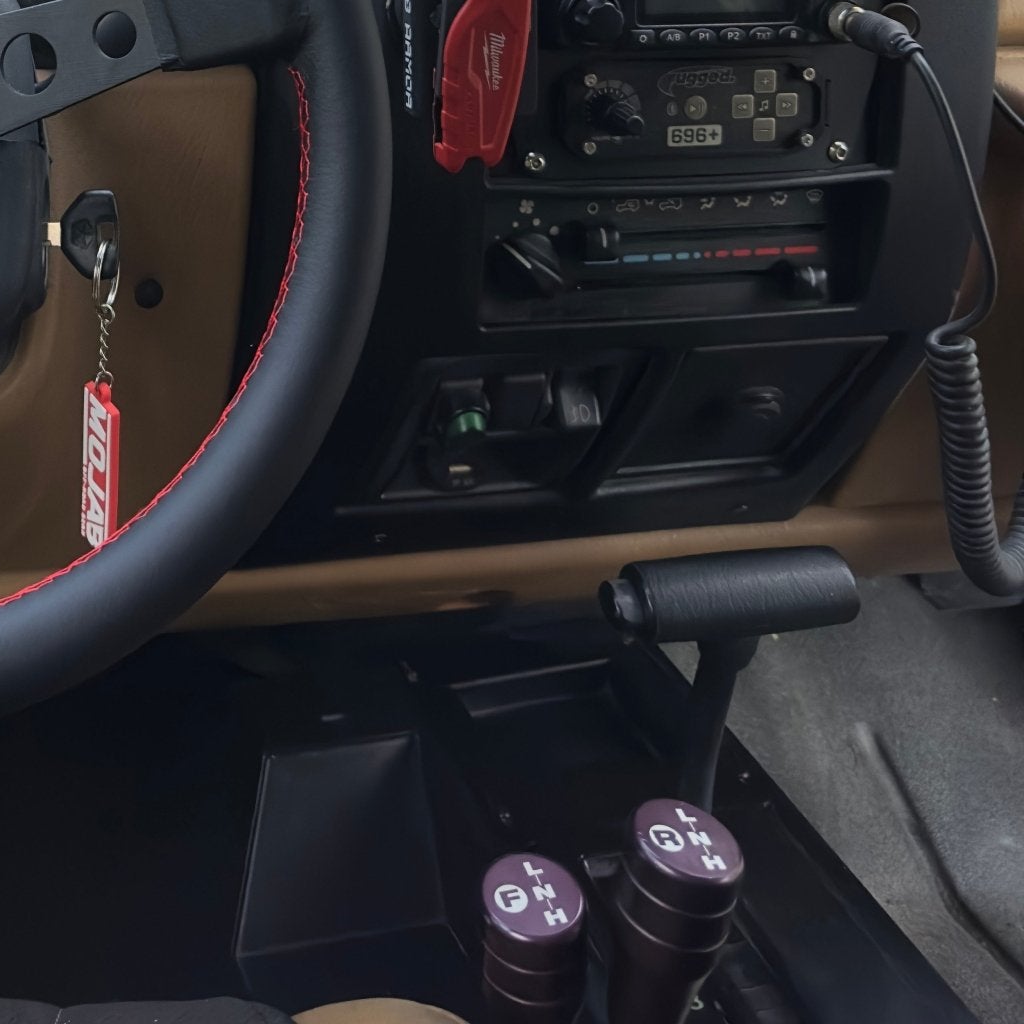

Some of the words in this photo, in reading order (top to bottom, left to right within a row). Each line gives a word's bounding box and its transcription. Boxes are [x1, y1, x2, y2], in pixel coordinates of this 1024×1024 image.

[666, 33, 681, 42] A/B
[698, 32, 710, 41] P1
[727, 31, 740, 41] P2
[403, 22, 413, 110] ARMOR
[488, 32, 506, 91] Milwaukee
[671, 128, 719, 144] 696+
[86, 392, 108, 548] MOJAB
[675, 808, 697, 824] L
[658, 829, 681, 847] R
[686, 831, 712, 847] N
[523, 861, 544, 877] L
[700, 855, 727, 871] H
[498, 888, 521, 908] F
[532, 884, 557, 901] N
[543, 908, 569, 926] H
